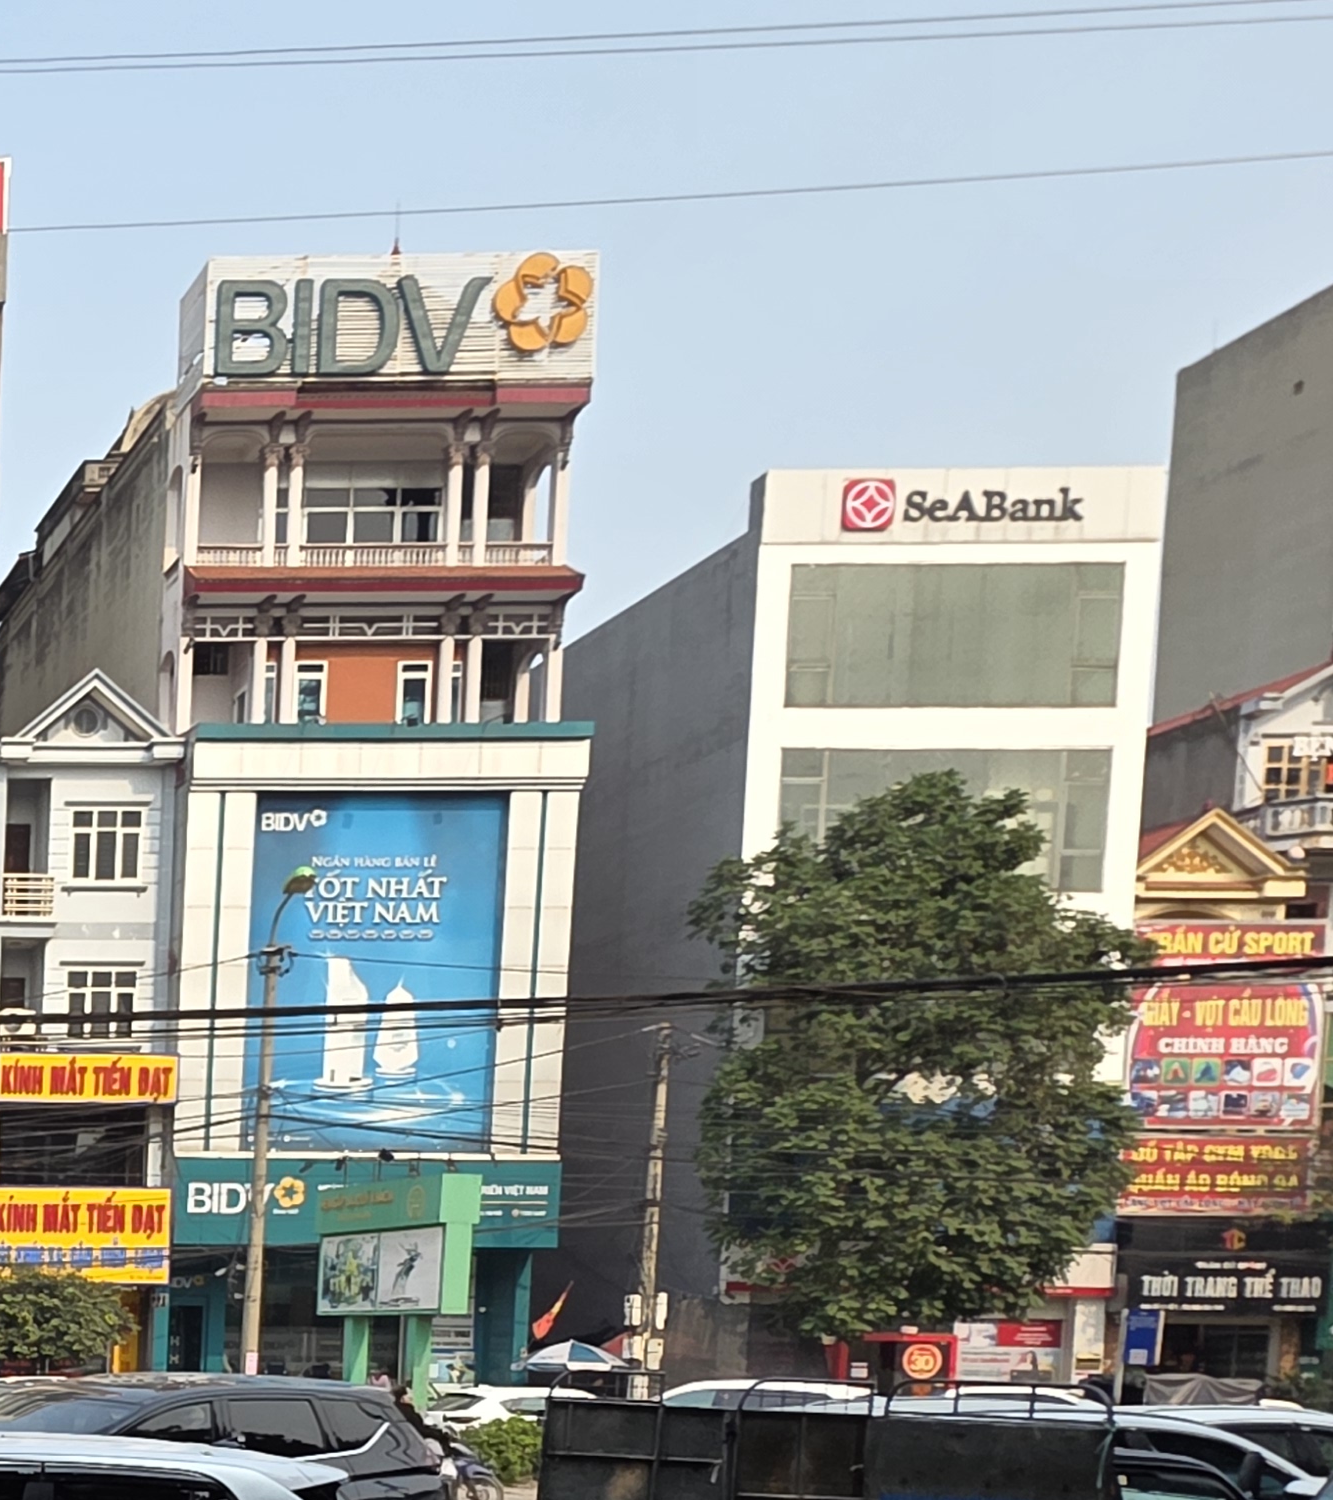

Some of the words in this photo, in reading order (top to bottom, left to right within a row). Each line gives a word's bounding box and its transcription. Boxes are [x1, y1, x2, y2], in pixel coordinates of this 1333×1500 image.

[214, 274, 494, 378] BIDV
[903, 486, 1084, 522] SeABank
[261, 812, 310, 832] BIDV
[366, 868, 448, 899] NHẤT
[304, 897, 369, 928] VIỆT
[372, 901, 441, 924] NAM
[1243, 931, 1315, 955] SPORT
[1158, 1035, 1226, 1053] CHÍNH
[0, 1058, 45, 1095] KÍNH
[92, 1056, 132, 1096] TIẾN
[42, 1190, 82, 1234] MẮT
[87, 1190, 126, 1234] TIẾN
[131, 1204, 166, 1241] ĐẠT
[1140, 1270, 1179, 1298] THỜI
[1184, 1276, 1238, 1299] TRANG
[1279, 1276, 1323, 1299] THAO
[908, 1353, 935, 1371] 30
